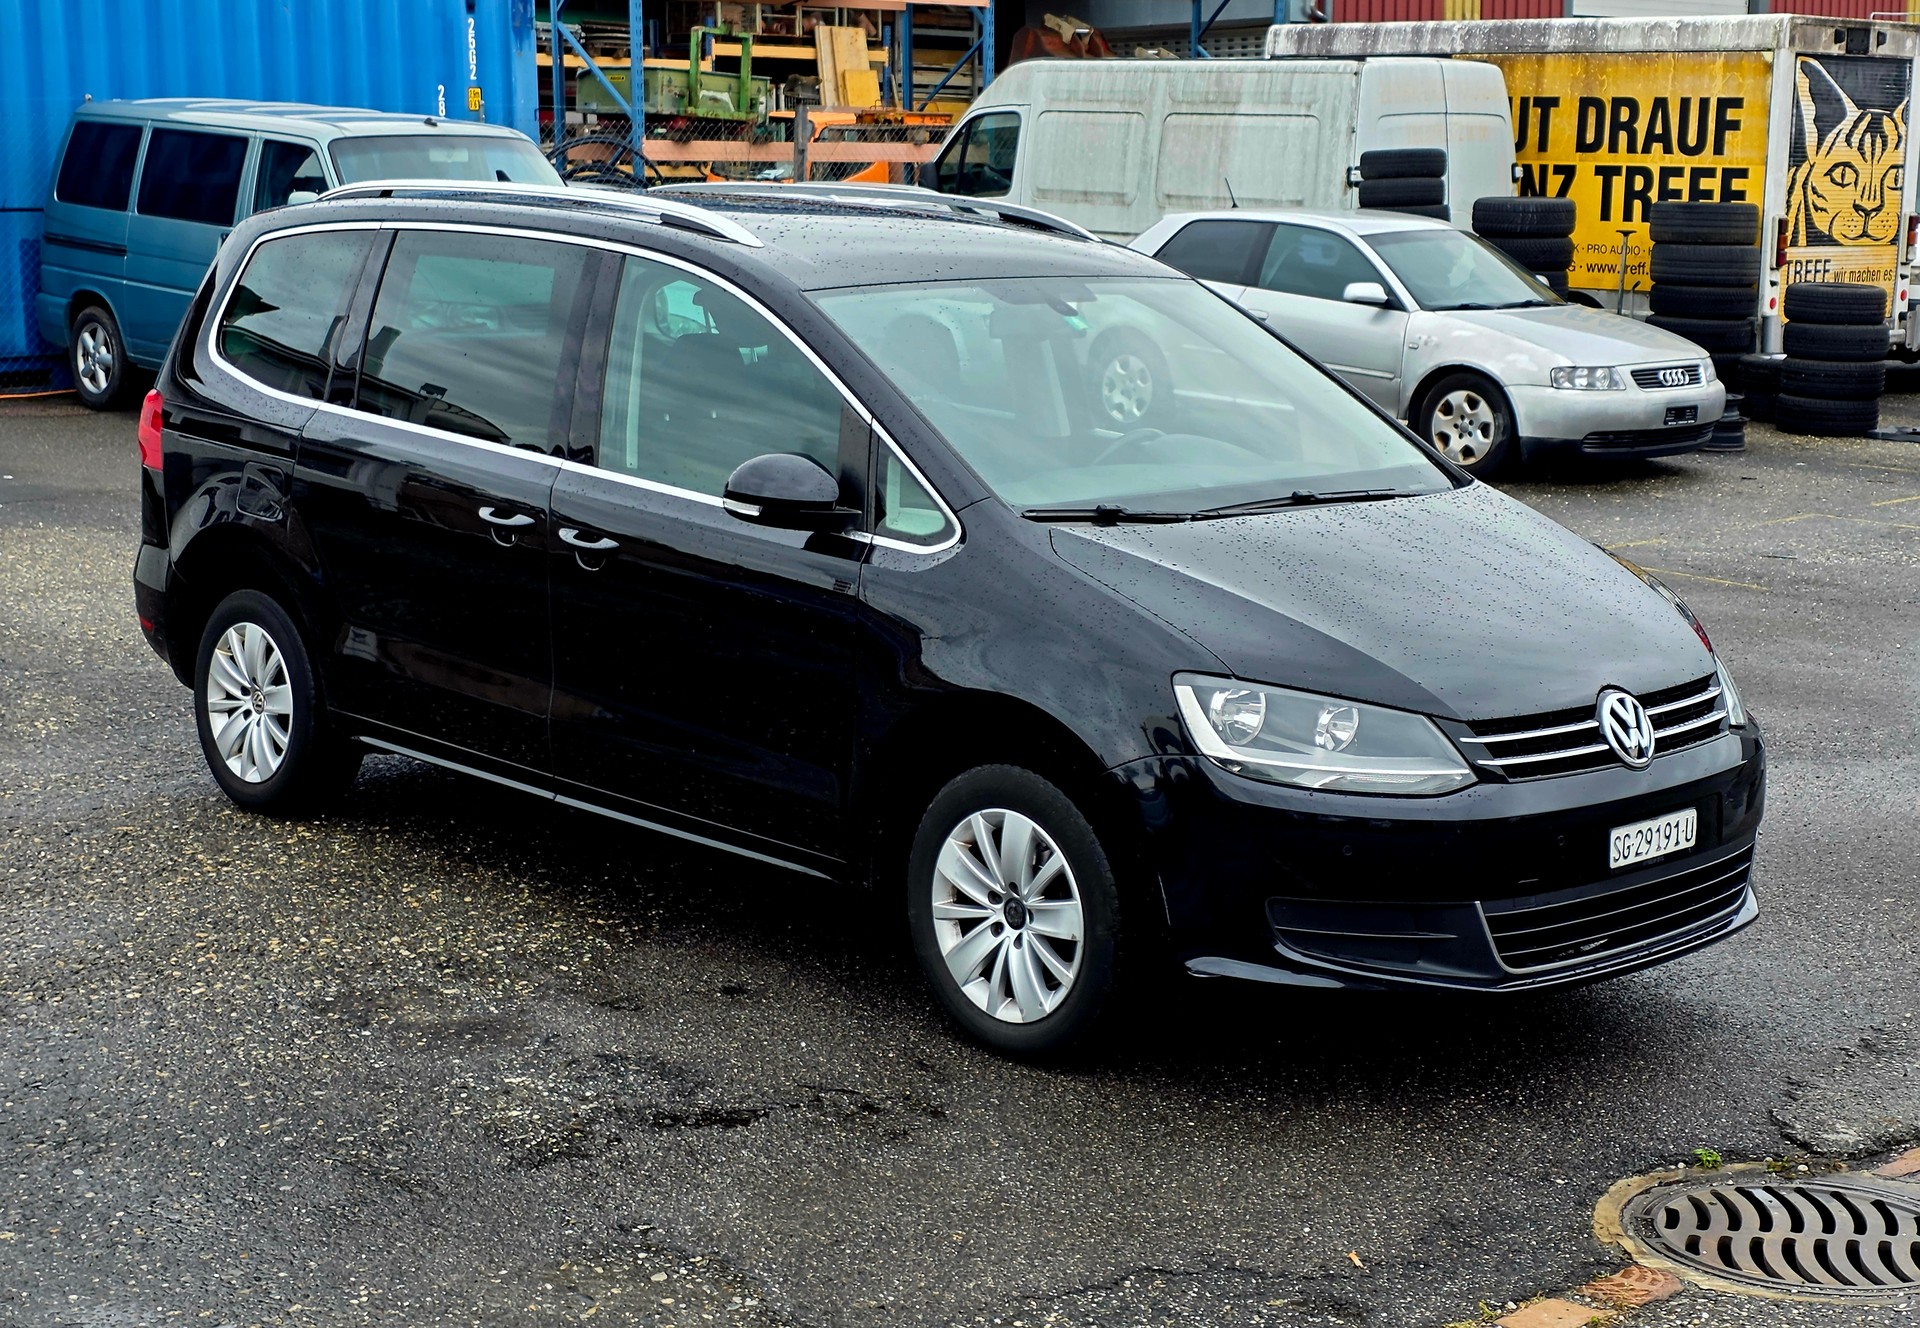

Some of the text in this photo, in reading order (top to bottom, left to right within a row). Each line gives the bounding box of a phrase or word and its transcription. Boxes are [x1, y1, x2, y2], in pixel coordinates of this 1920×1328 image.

[1575, 96, 1744, 156] DRAUF
[1586, 243, 1608, 254] PRO
[1786, 259, 1893, 285] TREFF wir machen es
